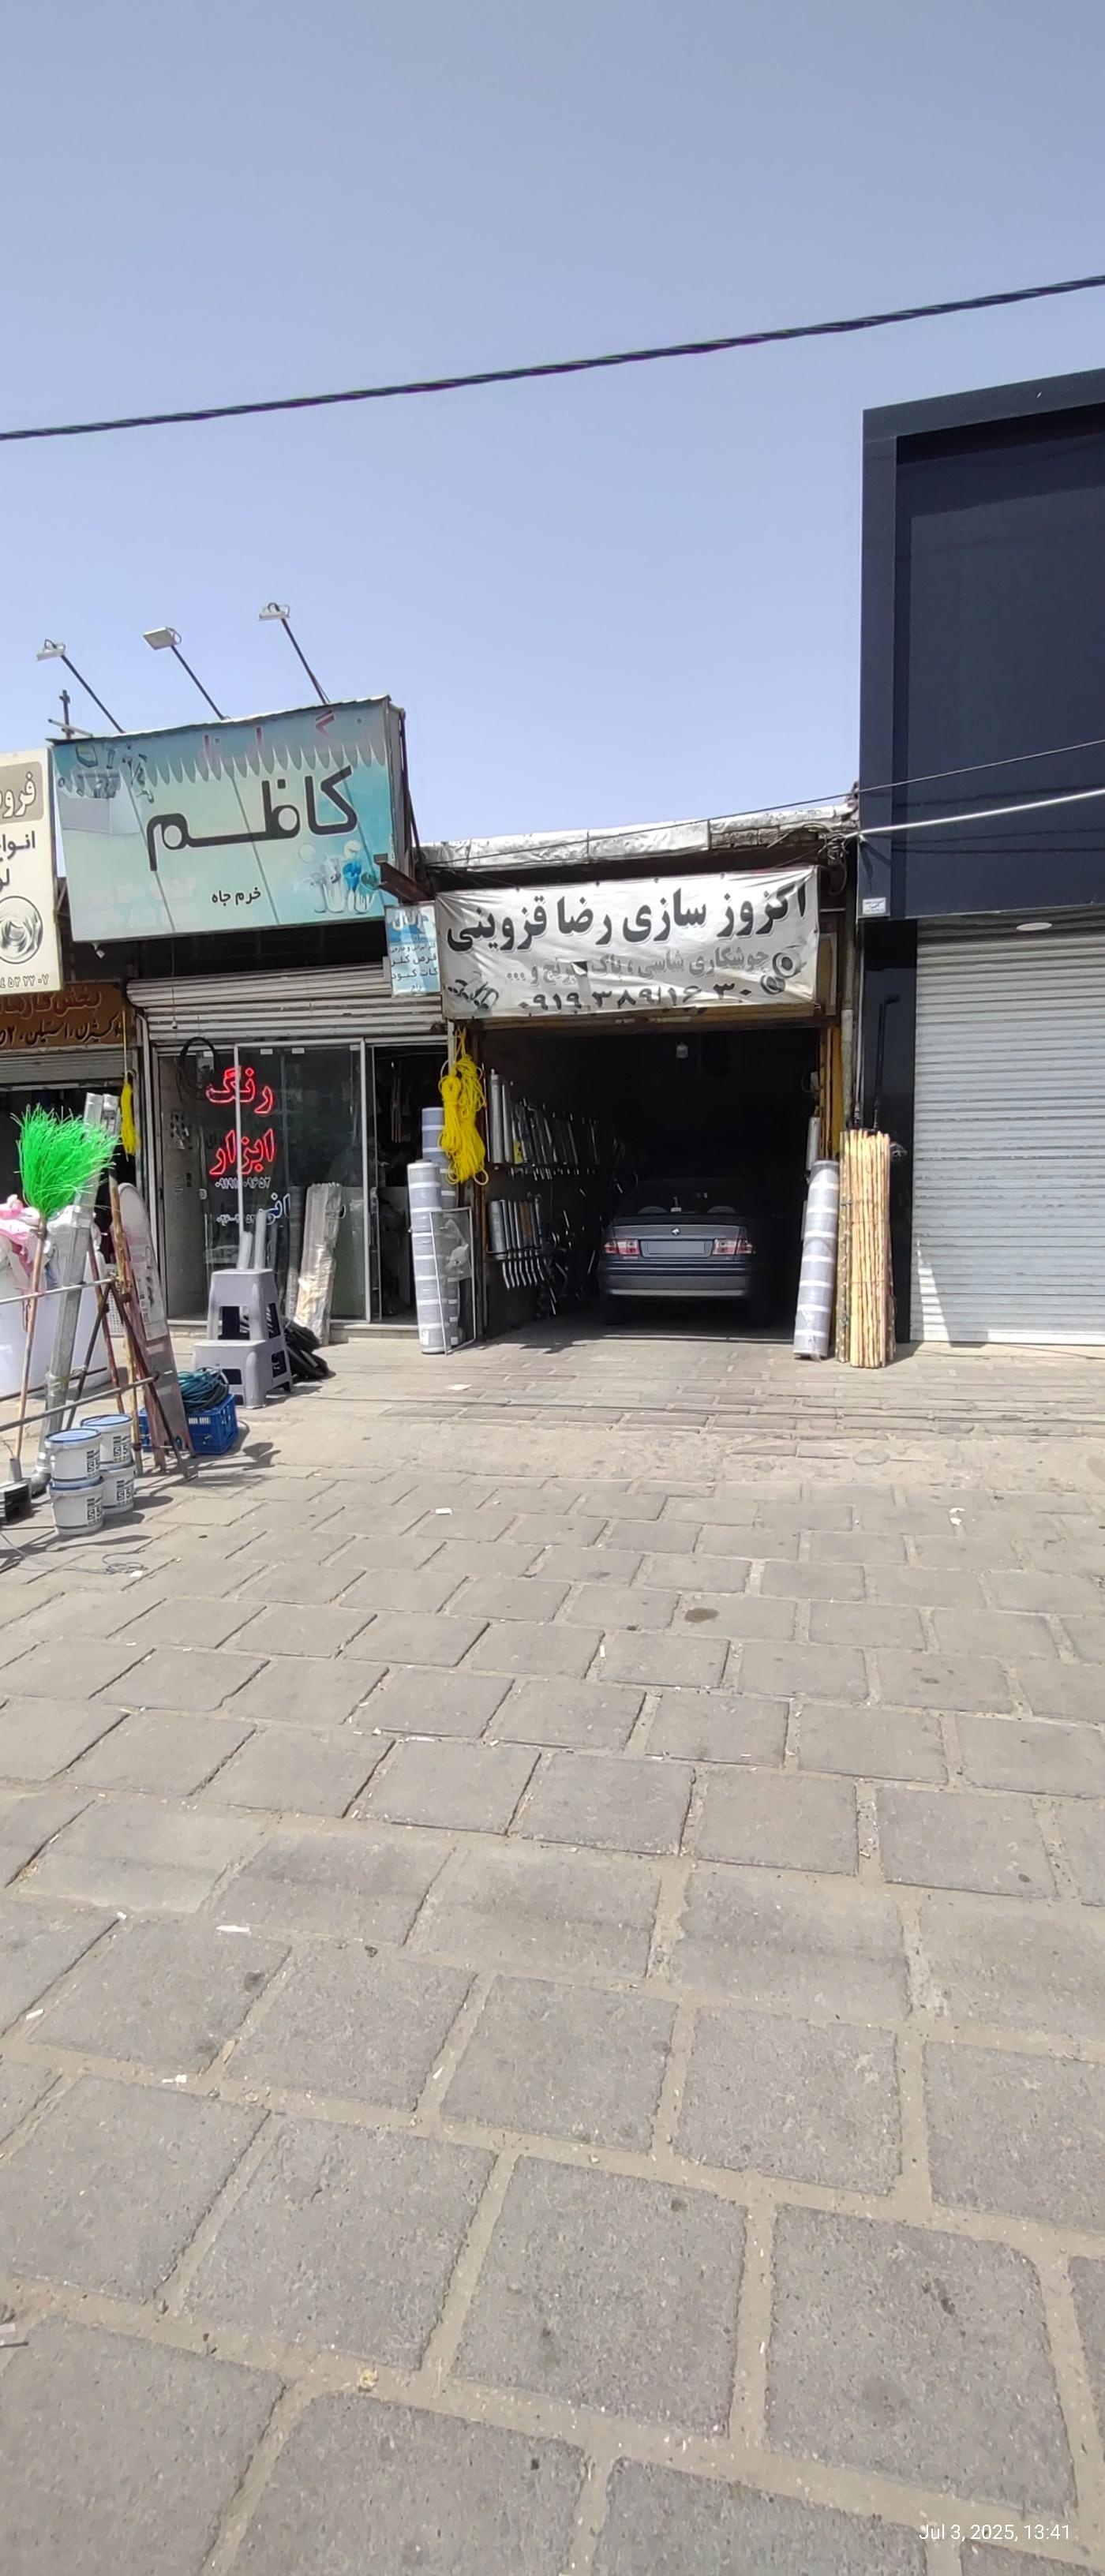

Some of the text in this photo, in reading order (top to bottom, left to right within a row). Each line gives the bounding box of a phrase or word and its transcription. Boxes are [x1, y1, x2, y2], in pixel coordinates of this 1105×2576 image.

[0, 771, 36, 818] فرو
[147, 766, 358, 871] کاظم
[0, 830, 36, 861] انوا
[212, 887, 261, 905] خرم جاه
[622, 888, 706, 942] سازی
[448, 896, 547, 952] قزوینی
[557, 896, 612, 945] رضا
[391, 955, 410, 967] کلر
[391, 967, 438, 981] کات کبود
[530, 965, 538, 986] و
[688, 947, 770, 977] جوشکاری
[206, 1066, 274, 1114] رنگ
[209, 1128, 275, 1174] ابزار
